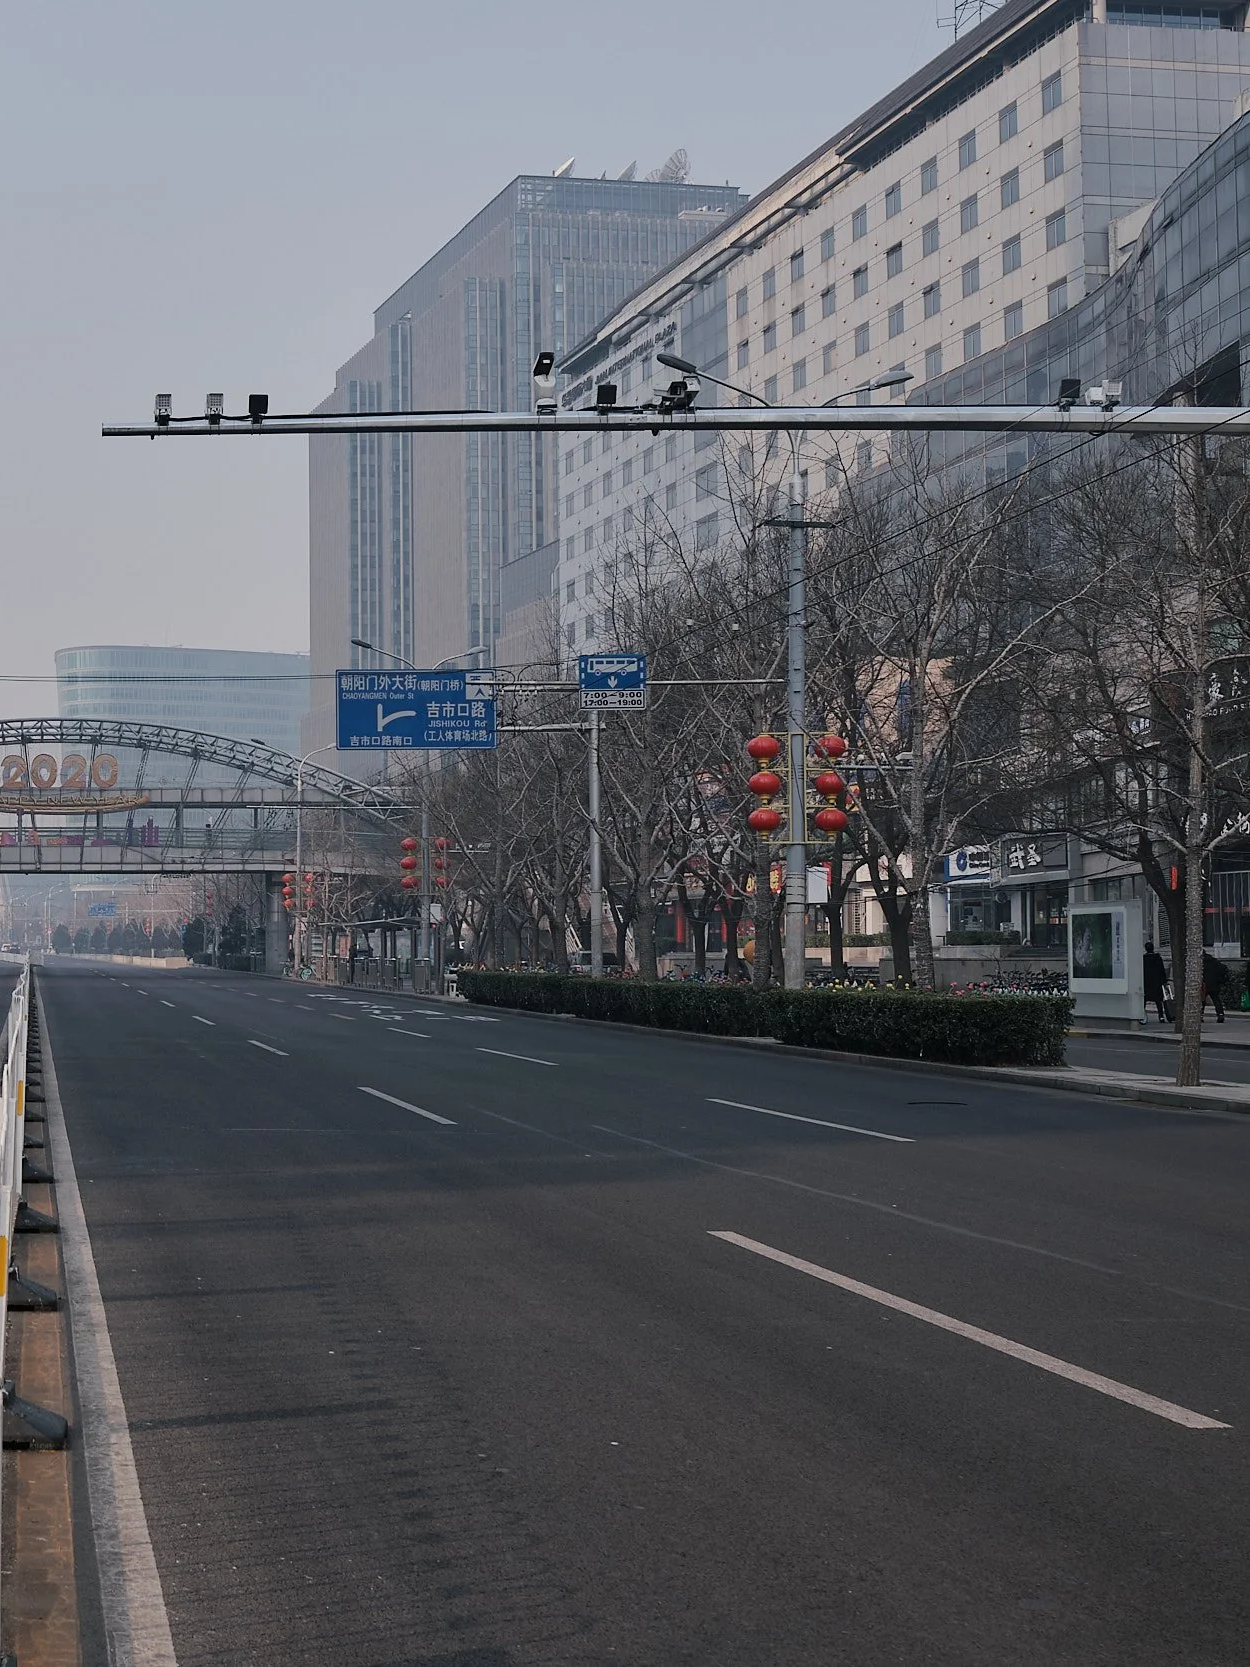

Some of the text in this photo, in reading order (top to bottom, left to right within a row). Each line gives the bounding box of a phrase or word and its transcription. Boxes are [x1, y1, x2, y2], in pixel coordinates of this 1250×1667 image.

[340, 674, 417, 691] 朝阳门外大街
[426, 701, 486, 718] 吉市口路
[350, 735, 412, 746] 吉市口路南口
[0, 753, 118, 789] 2020
[47, 795, 91, 805] NEW
[94, 794, 140, 805] YEAR
